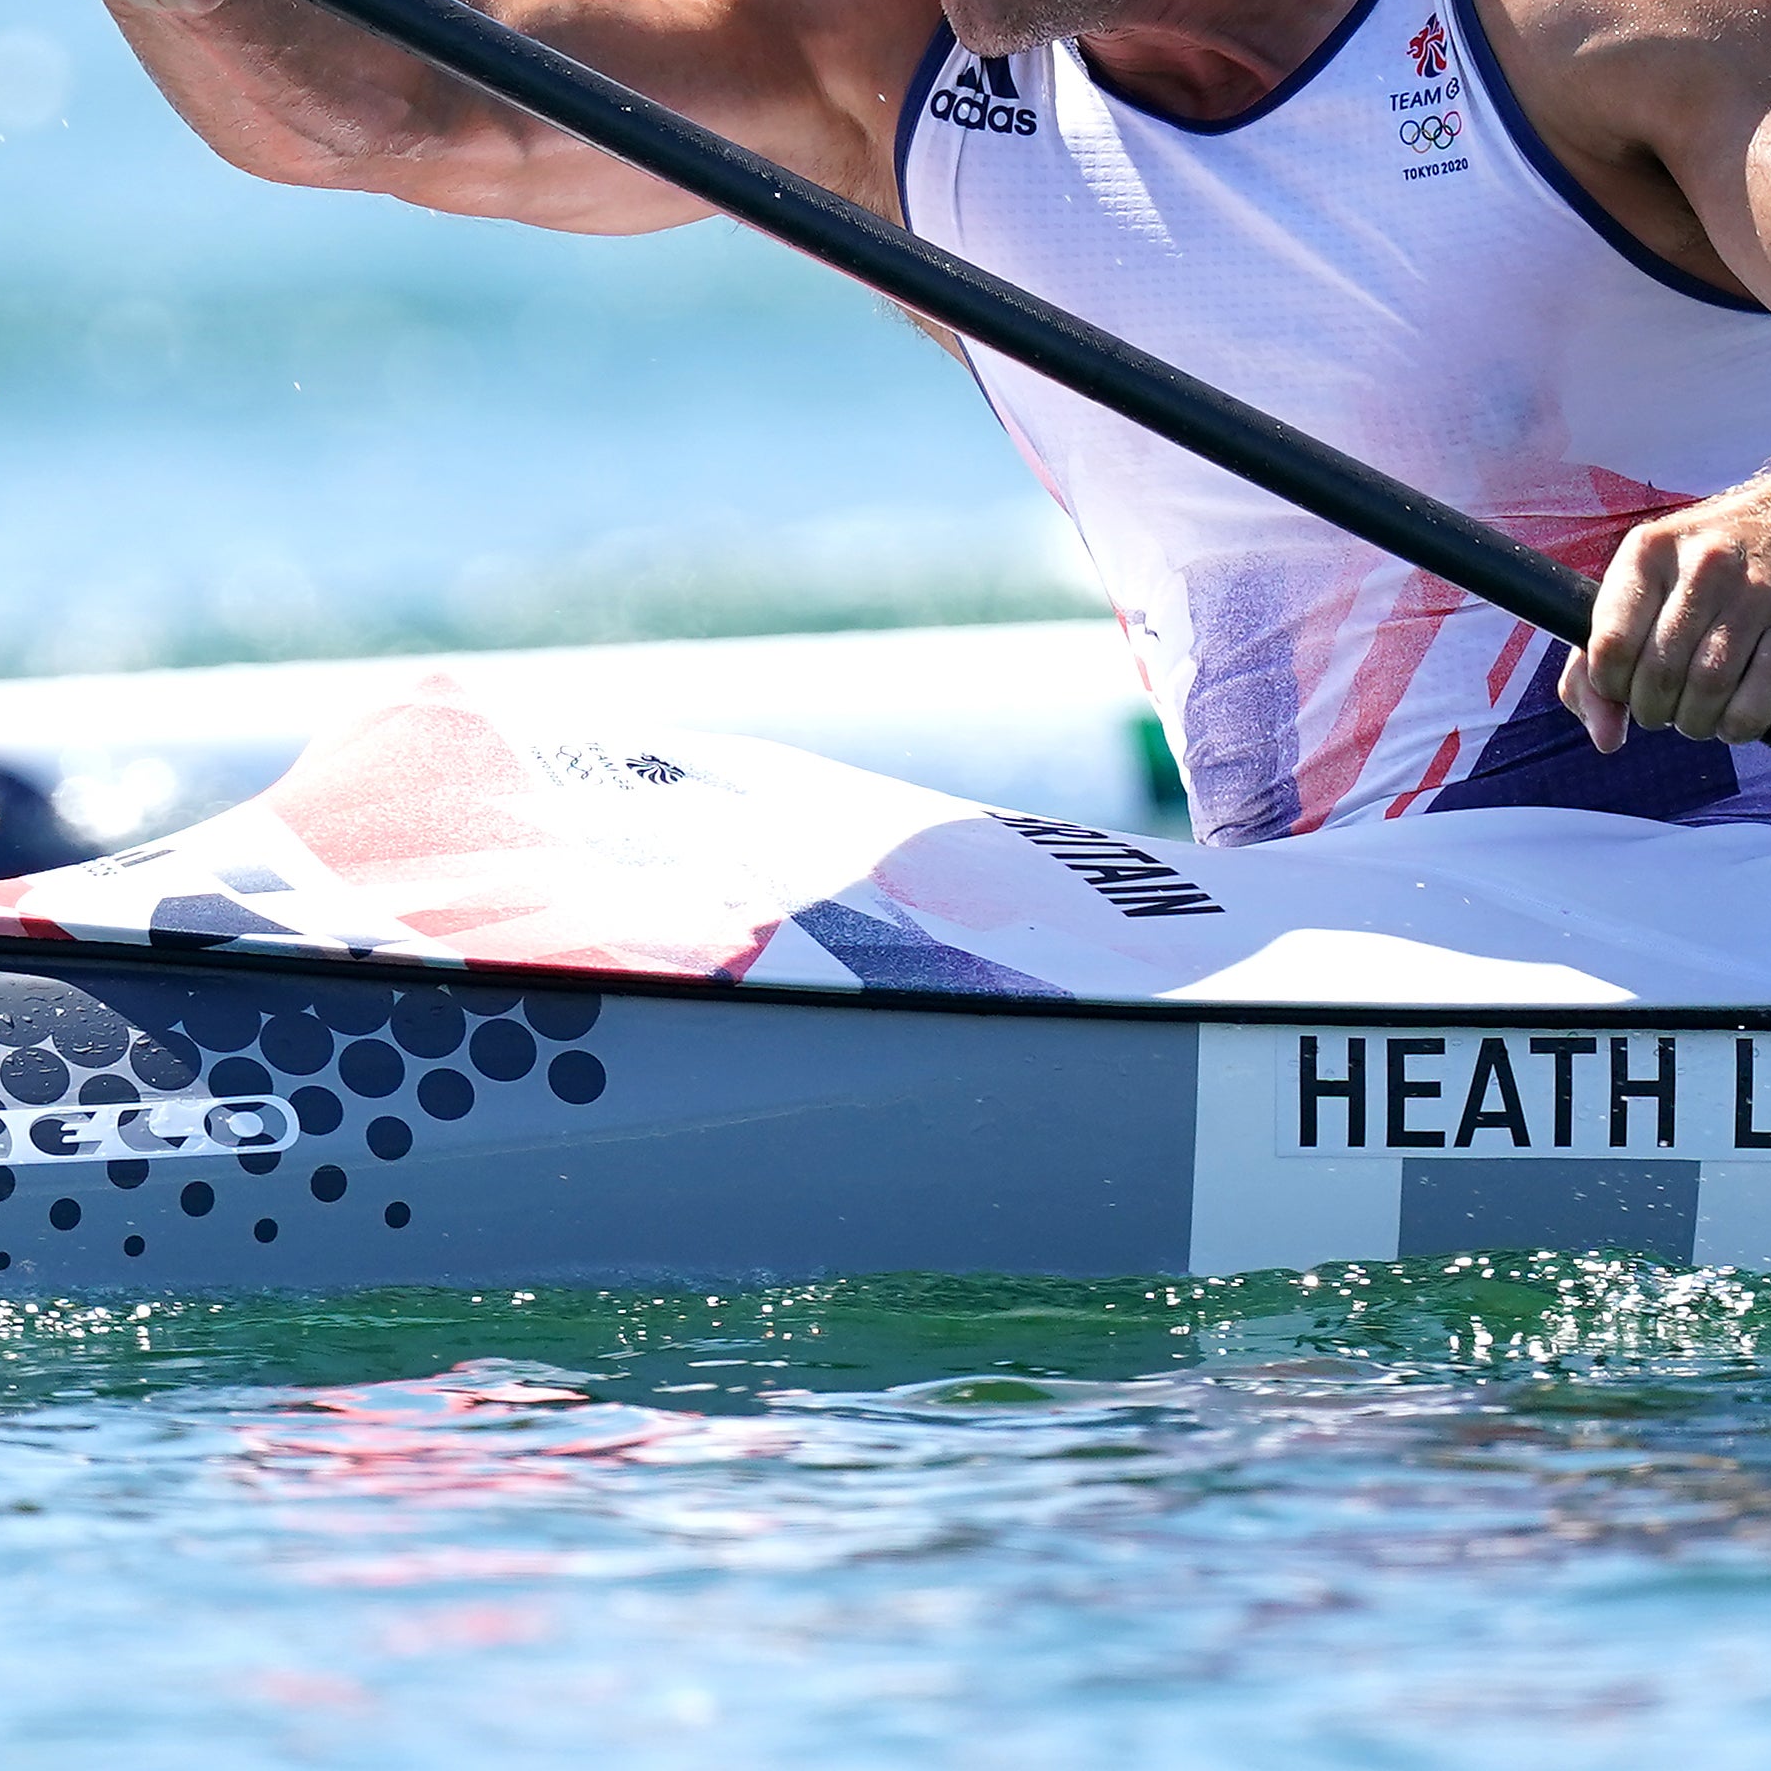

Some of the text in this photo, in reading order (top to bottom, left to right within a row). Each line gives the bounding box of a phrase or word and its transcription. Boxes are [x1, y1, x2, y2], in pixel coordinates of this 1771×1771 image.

[930, 89, 1038, 135] addas
[1390, 86, 1441, 111] TEAM
[1403, 158, 1469, 181] TOKYO 2020
[1299, 1035, 1676, 1148] HEATH
